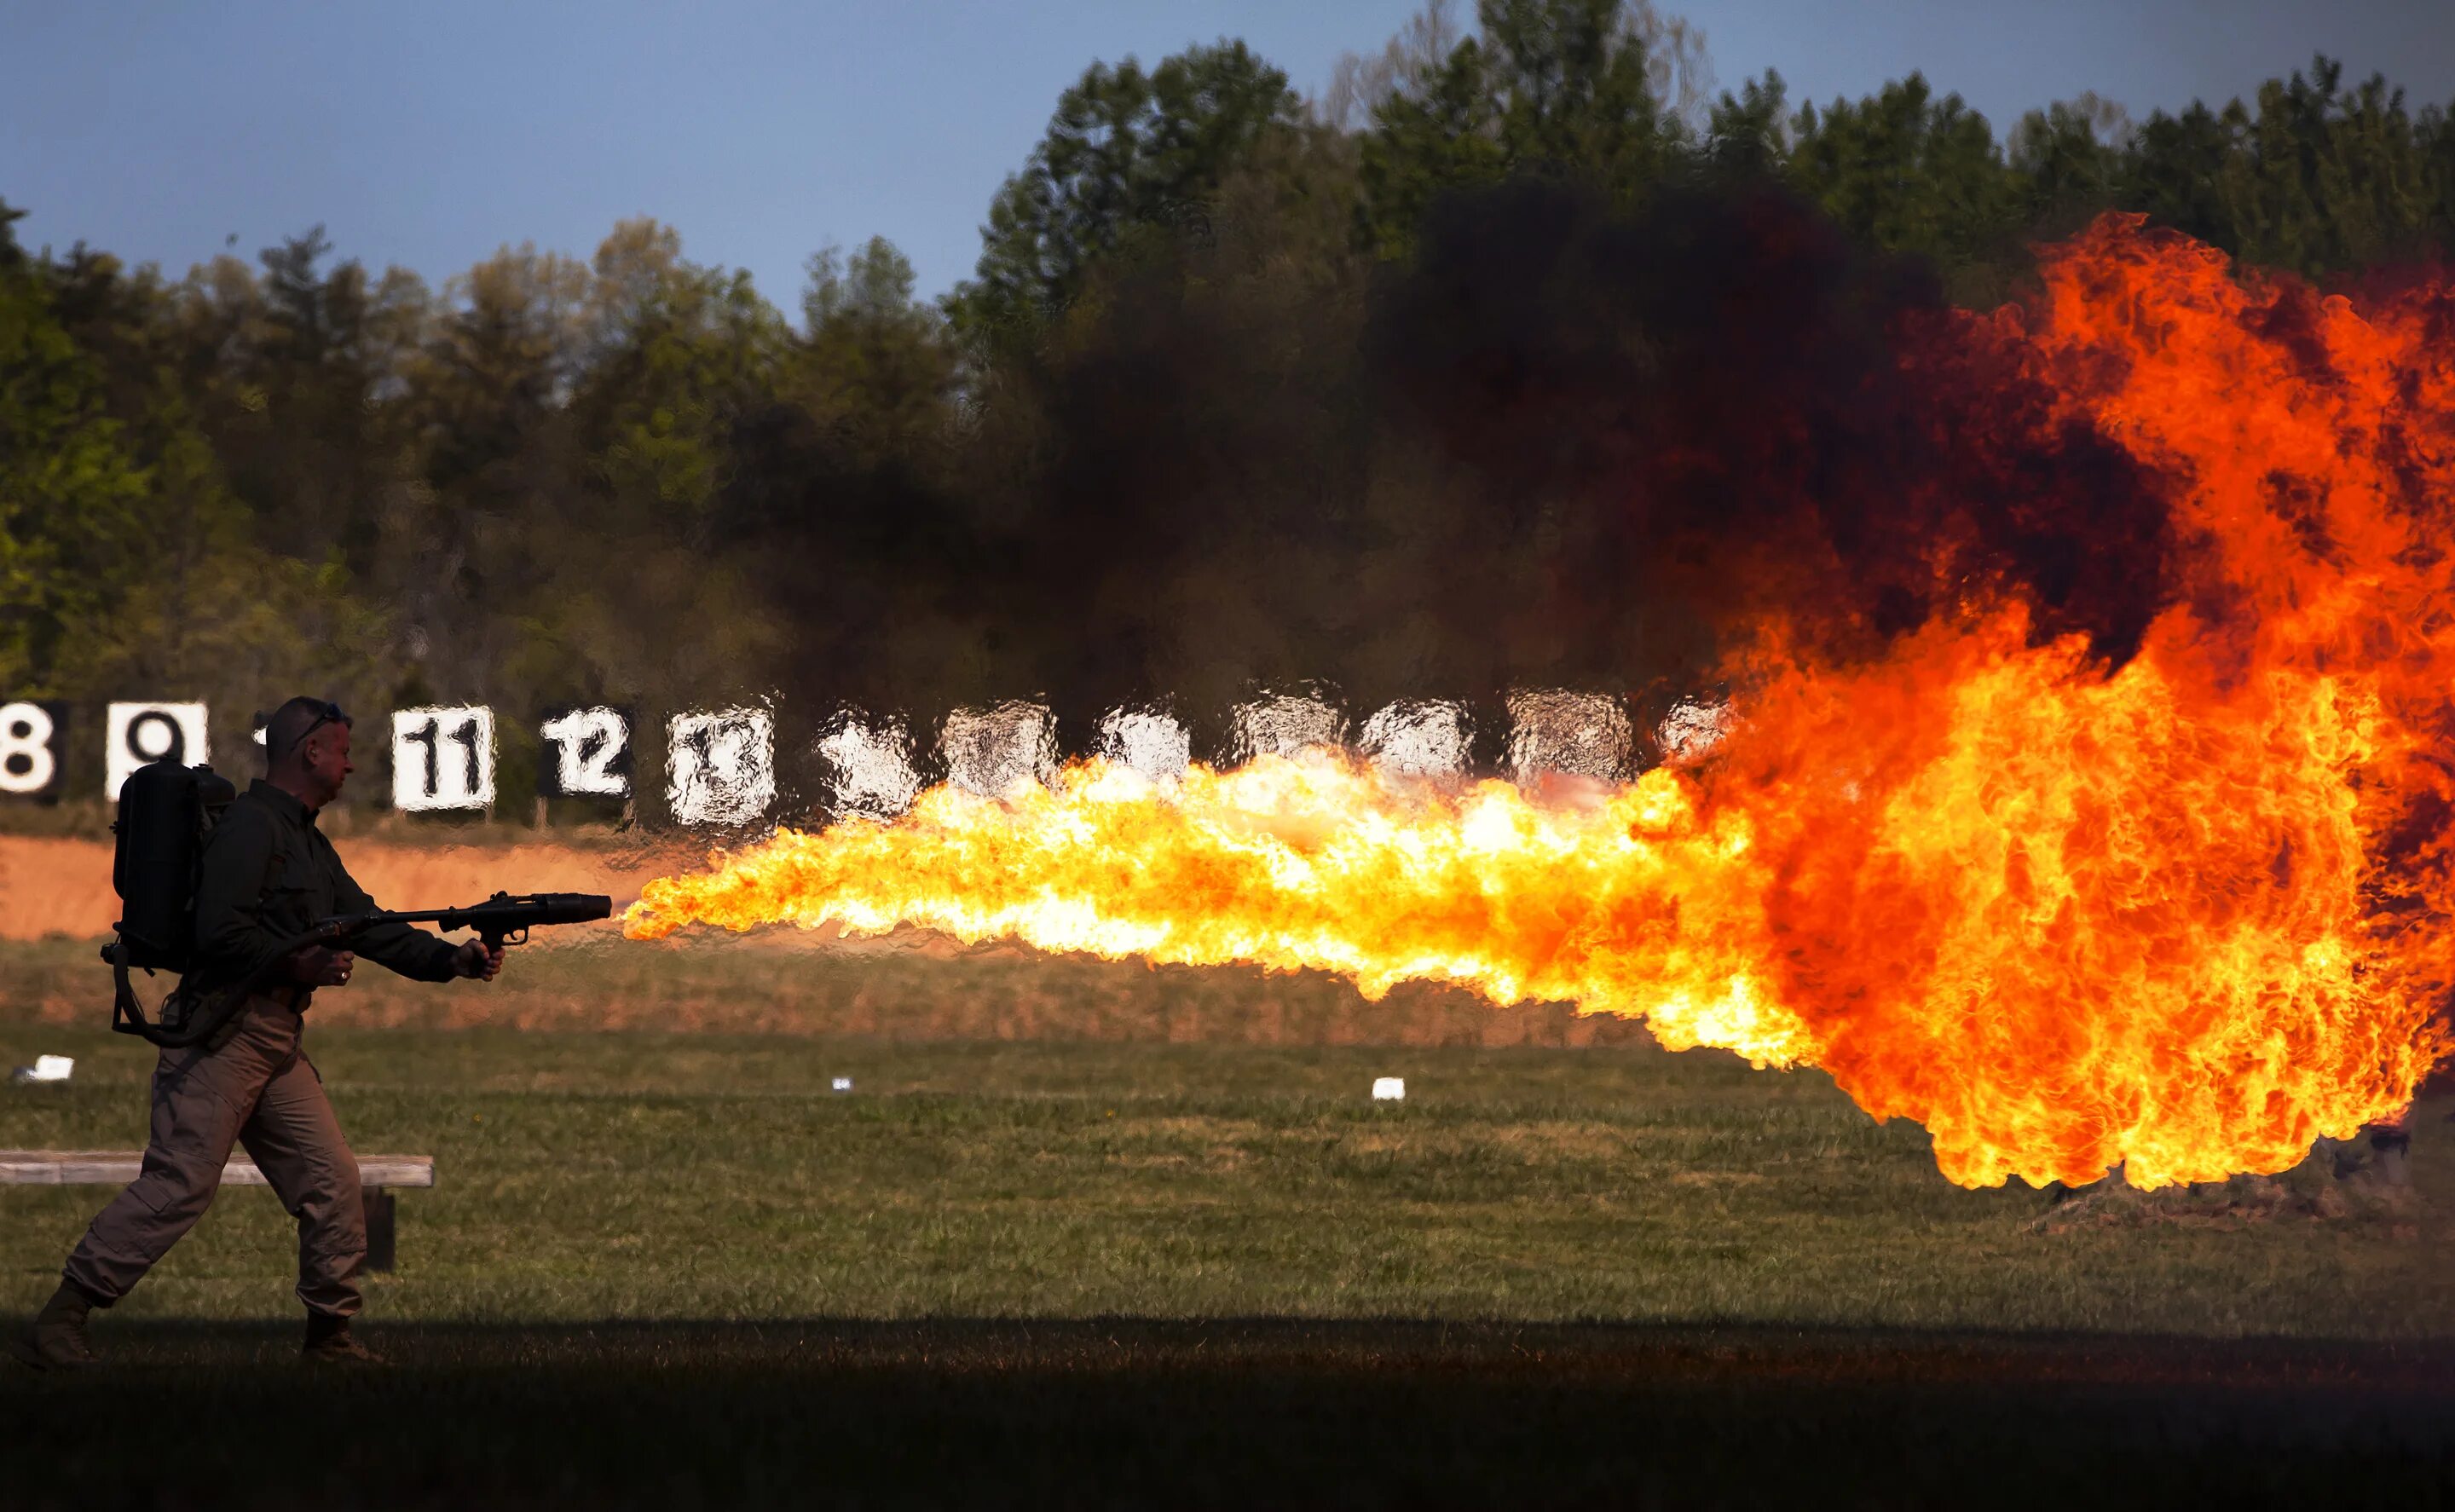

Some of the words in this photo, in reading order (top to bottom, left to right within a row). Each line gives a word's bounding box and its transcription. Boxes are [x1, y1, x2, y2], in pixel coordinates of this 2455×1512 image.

[0, 701, 55, 793] 8
[128, 711, 185, 776] 9
[402, 717, 477, 797] 11
[540, 706, 629, 794] 12
